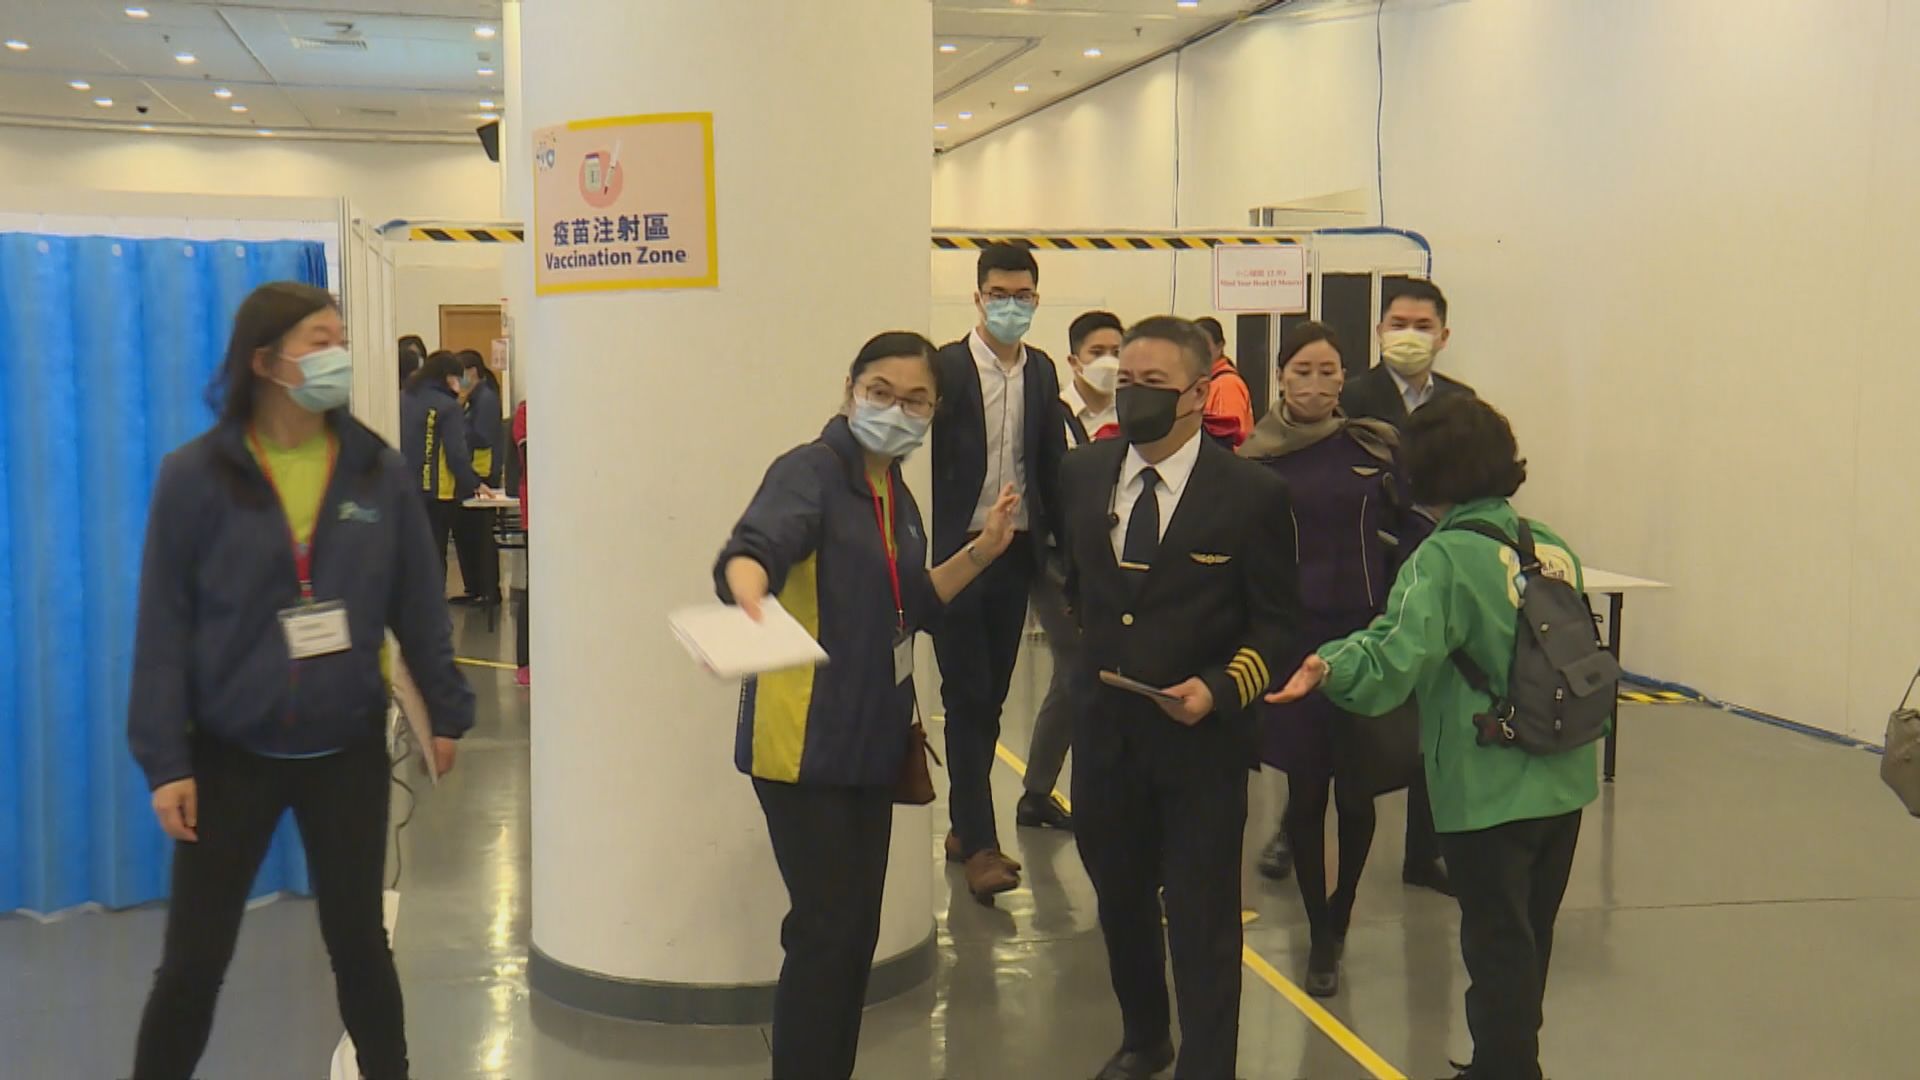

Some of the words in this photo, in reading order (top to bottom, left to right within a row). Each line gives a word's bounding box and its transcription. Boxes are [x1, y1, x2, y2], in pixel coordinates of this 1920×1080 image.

[553, 213, 670, 246] 疫苗注射區
[545, 248, 631, 270] Vaccination
[636, 247, 687, 264] Zone
